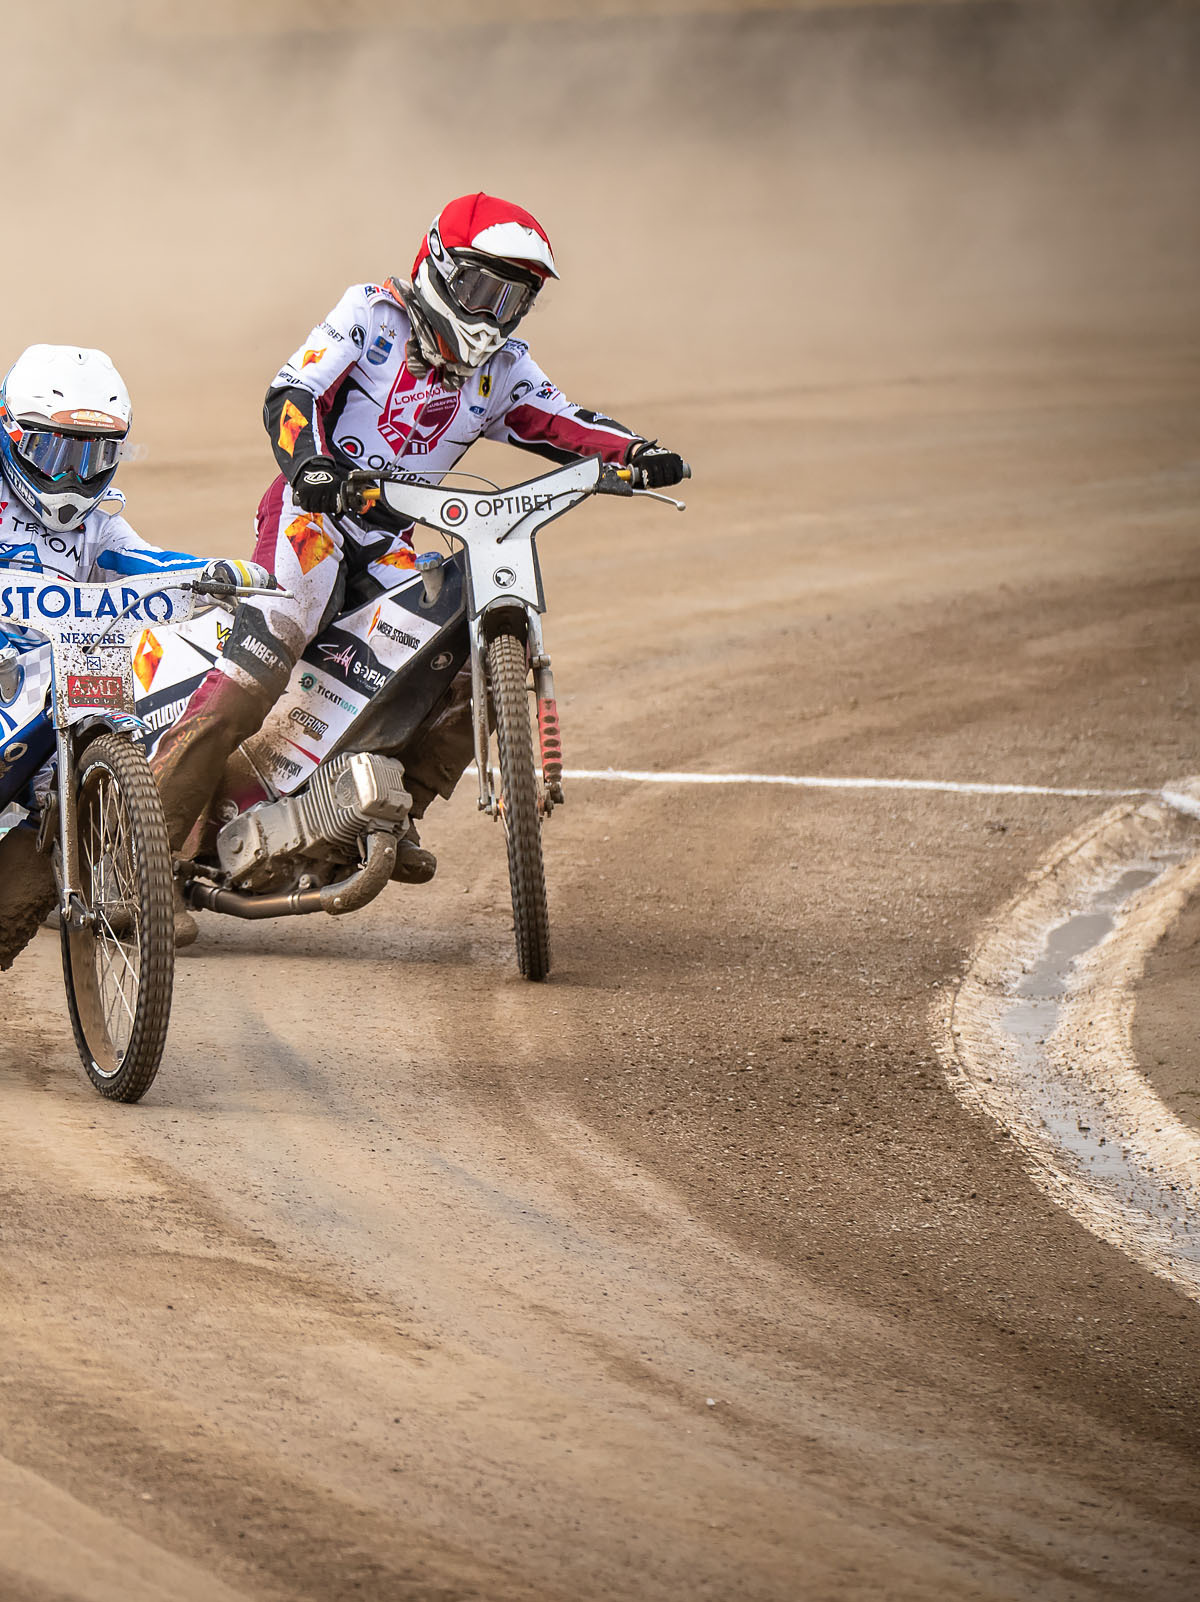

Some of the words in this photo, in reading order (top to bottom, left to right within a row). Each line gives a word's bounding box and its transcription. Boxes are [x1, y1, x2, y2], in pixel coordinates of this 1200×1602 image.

[367, 454, 432, 484] OPTIBE
[475, 494, 553, 517] OPTIBET
[1, 585, 173, 622] STOLARO
[60, 633, 125, 644] NEXORIS
[72, 679, 120, 696] AMD
[142, 697, 189, 735] STUDIO
